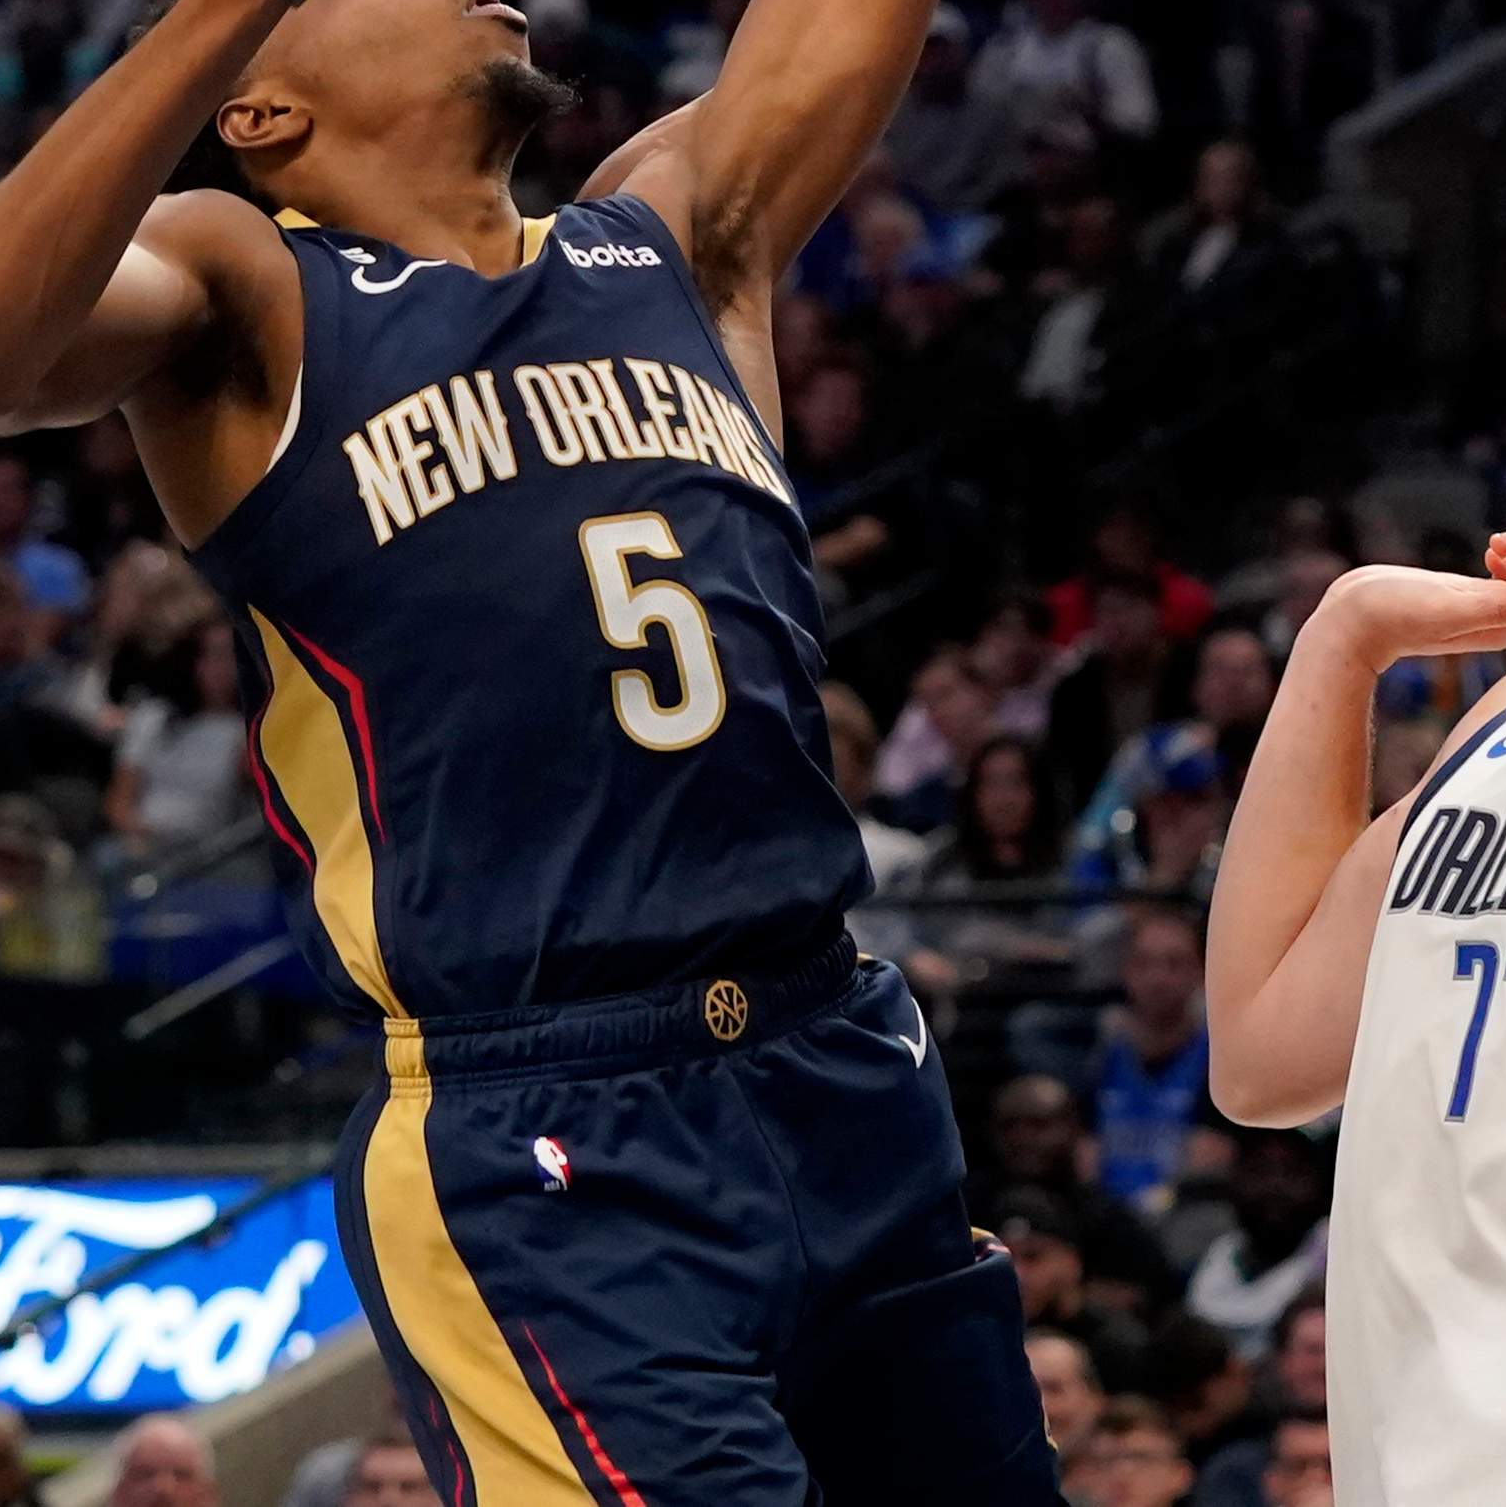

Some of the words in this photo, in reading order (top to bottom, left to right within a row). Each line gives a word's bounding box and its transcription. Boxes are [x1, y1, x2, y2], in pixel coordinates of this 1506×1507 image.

[341, 369, 519, 547] NEW
[513, 356, 792, 506] ORLEANS
[577, 510, 728, 752] 5
